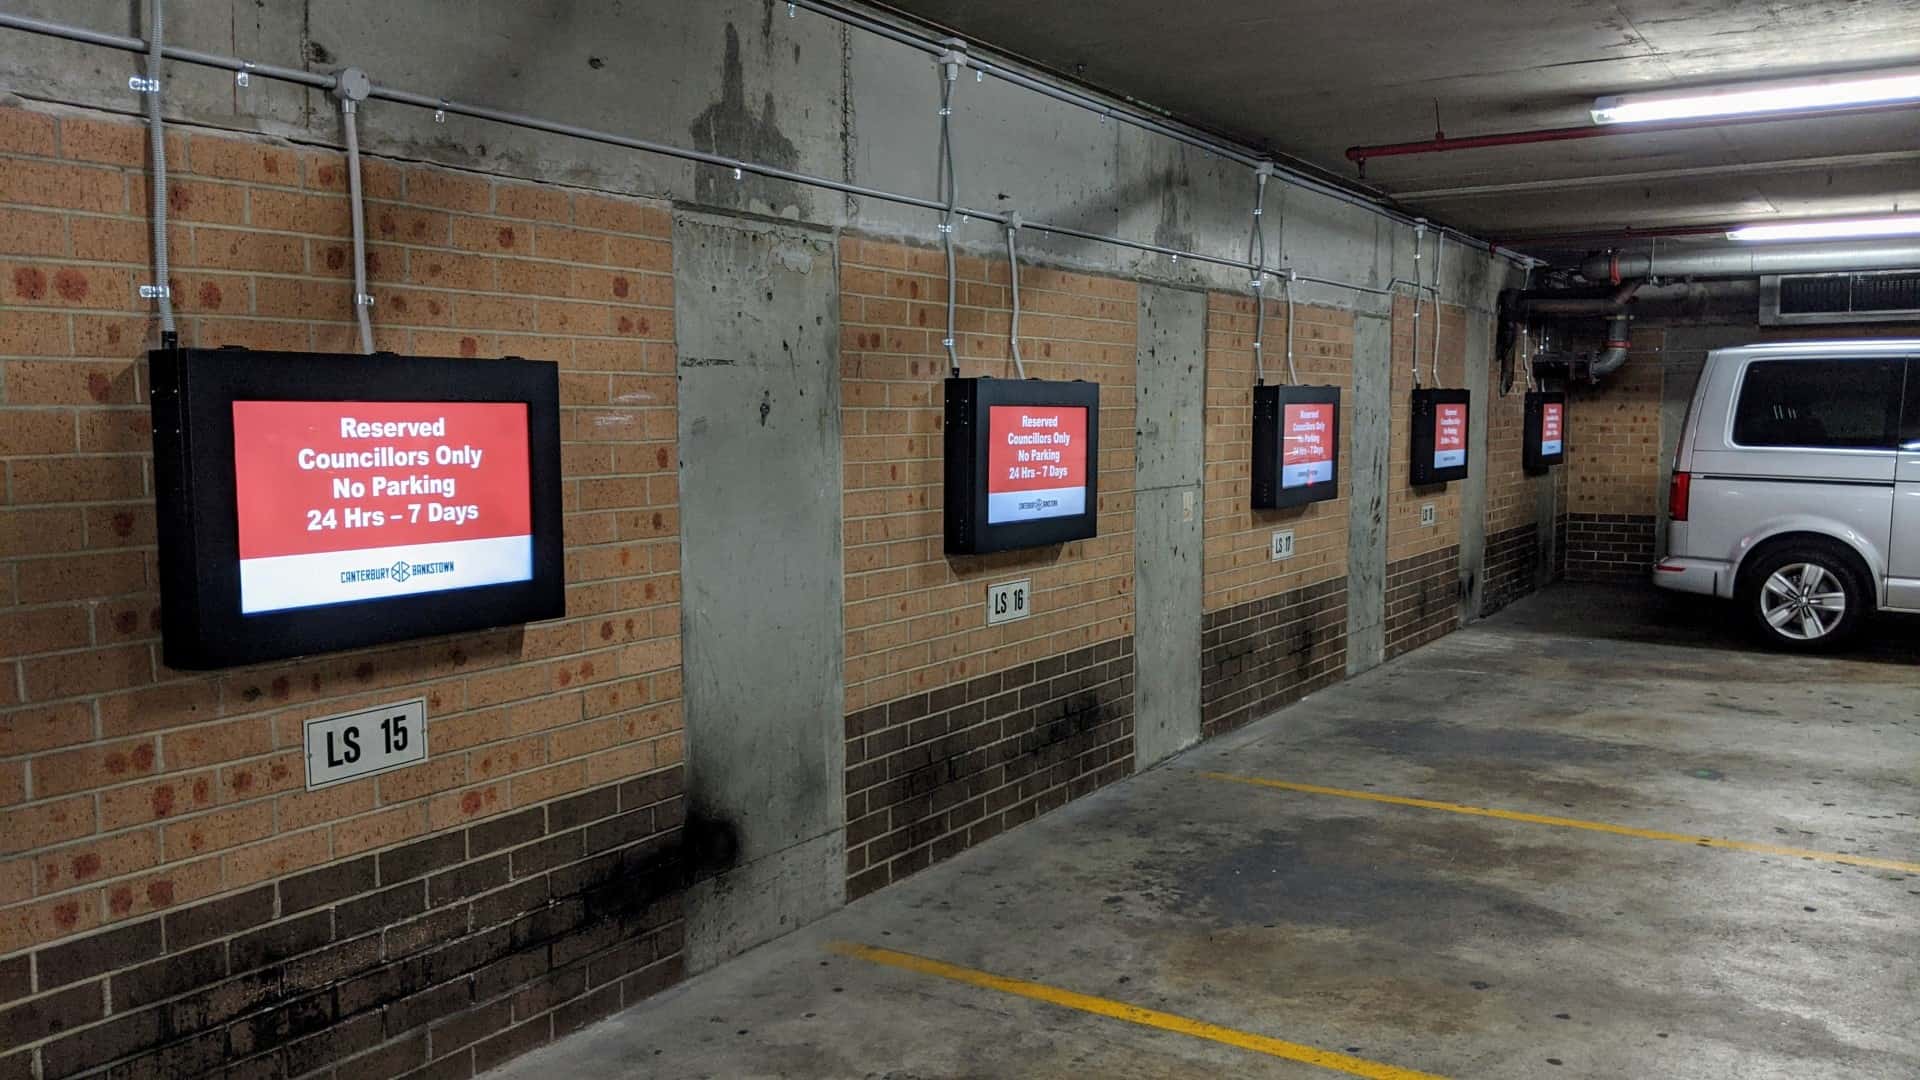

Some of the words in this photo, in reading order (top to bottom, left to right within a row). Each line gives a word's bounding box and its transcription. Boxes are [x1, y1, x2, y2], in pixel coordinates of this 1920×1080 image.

[341, 417, 446, 439] Reserved
[1022, 415, 1058, 428] Reserved
[1008, 432, 1051, 445] Councillors
[1053, 431, 1071, 446] Only
[298, 447, 430, 470] Councillors
[436, 445, 482, 469] Only
[1018, 450, 1030, 462] No
[1031, 448, 1060, 463] Parking
[1009, 467, 1019, 479] 24
[1021, 466, 1036, 478] Hrs
[1042, 466, 1048, 477] 7
[1050, 465, 1068, 479] Days
[333, 477, 365, 499] No
[372, 475, 455, 498] Parking
[307, 509, 338, 531] 24
[344, 507, 385, 529] Hrs
[407, 504, 422, 524] 7
[429, 502, 479, 525] Days
[1275, 537, 1283, 554] LS
[1286, 535, 1291, 552] 17
[340, 568, 390, 583] CANTERBURY
[413, 560, 455, 576] BANKSTOWN
[995, 592, 1007, 615] LS
[1014, 588, 1024, 611] 16
[327, 726, 361, 768] LS
[381, 715, 408, 754] 15
